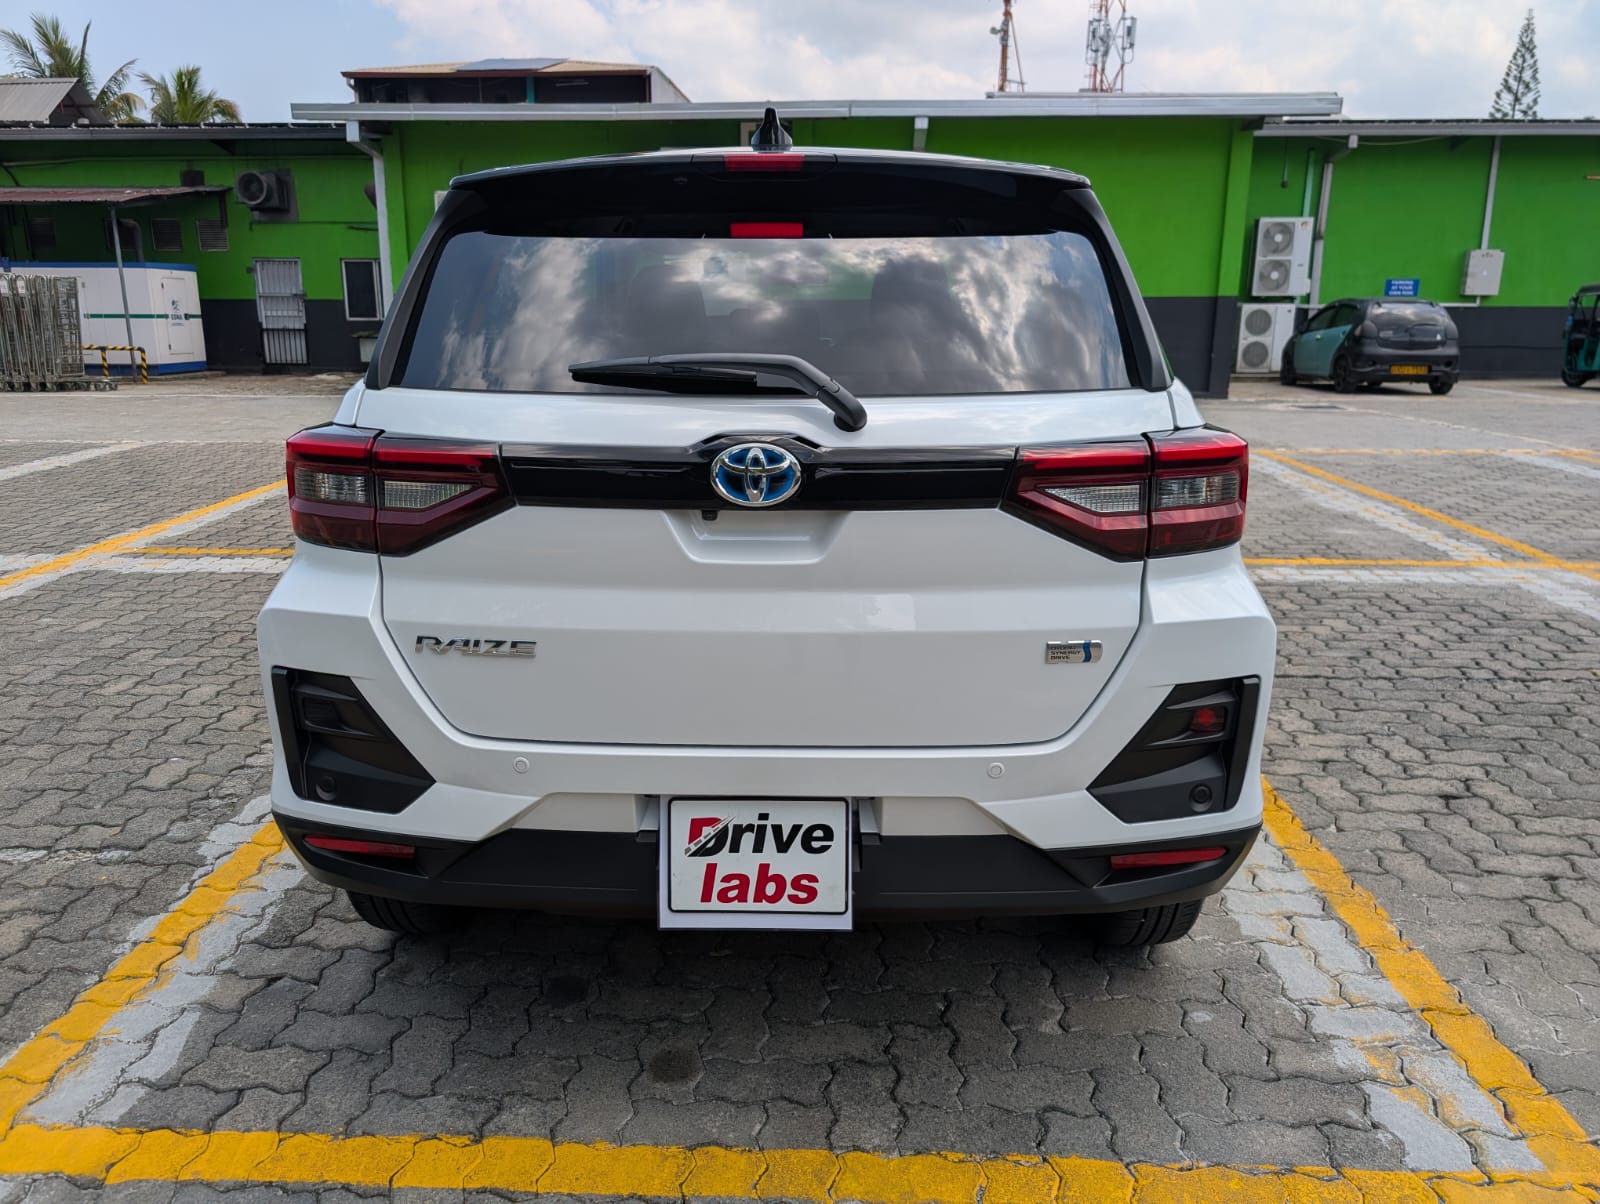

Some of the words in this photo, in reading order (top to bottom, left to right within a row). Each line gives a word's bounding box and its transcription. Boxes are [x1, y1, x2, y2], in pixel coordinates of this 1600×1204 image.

[415, 635, 537, 658] RAIZE
[685, 812, 835, 857] Drive
[700, 863, 820, 905] labs
